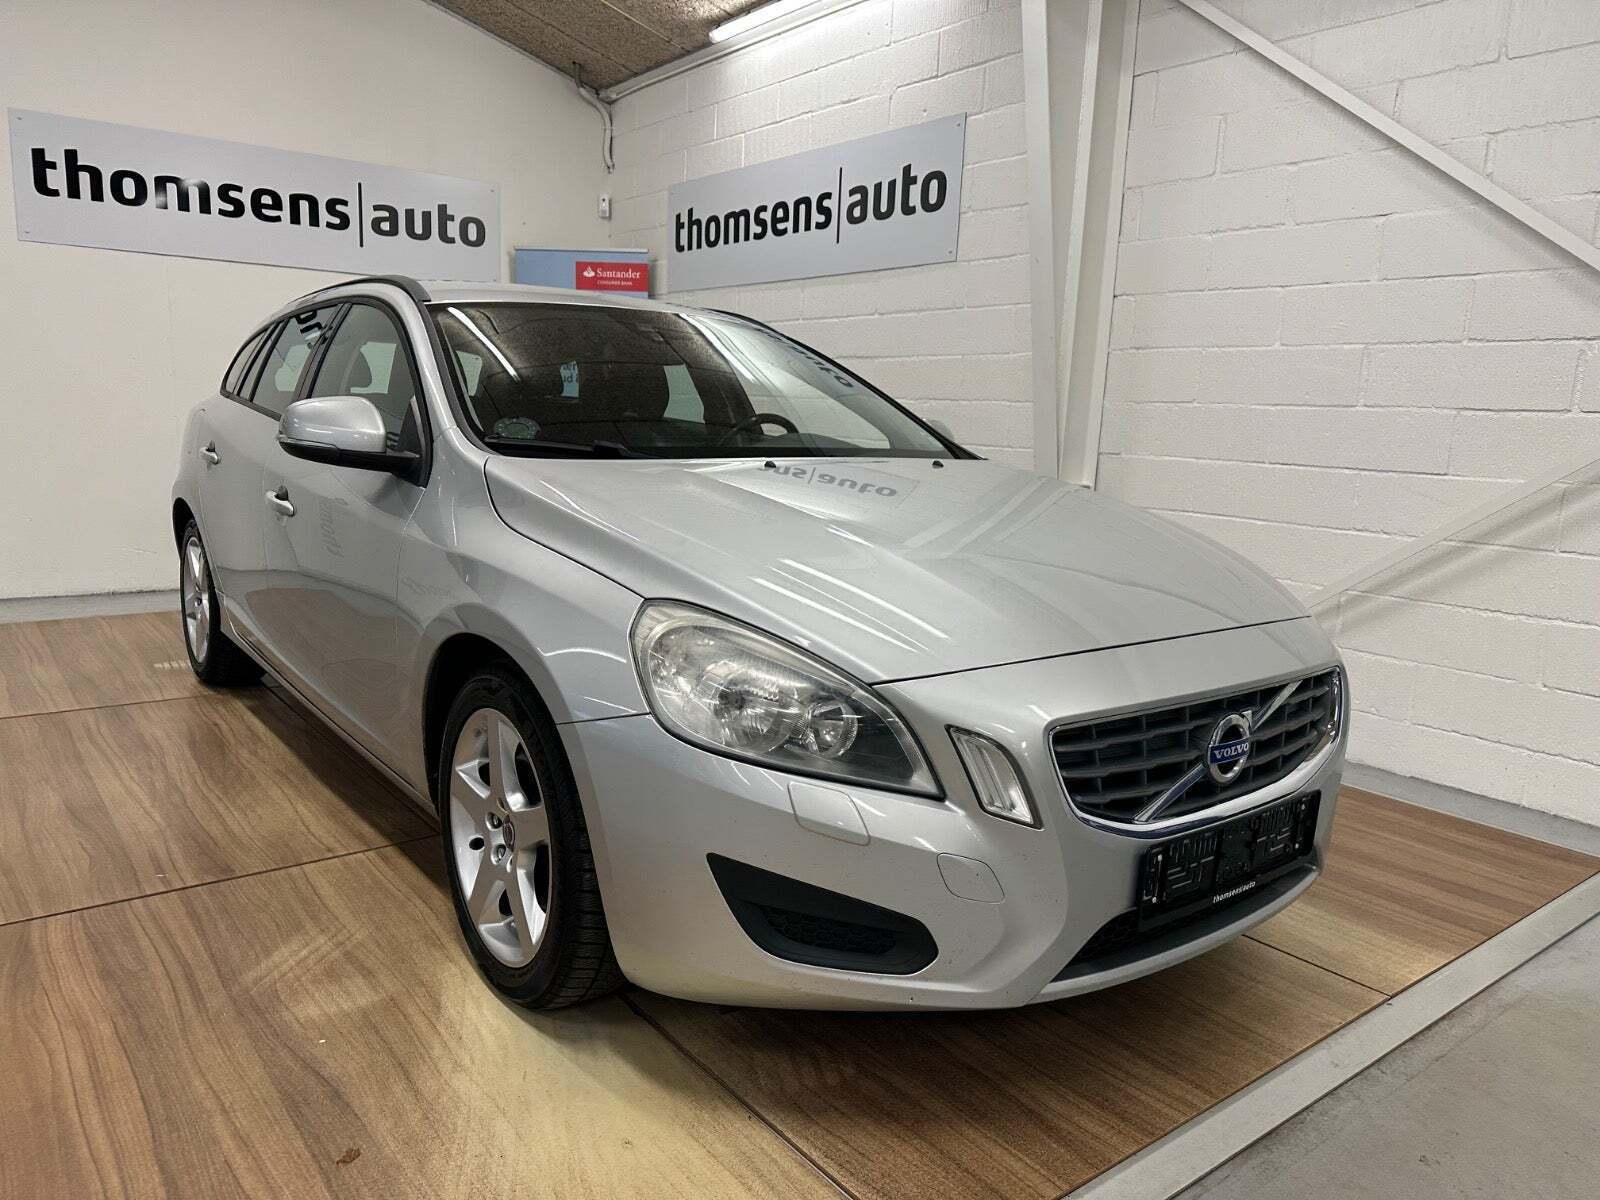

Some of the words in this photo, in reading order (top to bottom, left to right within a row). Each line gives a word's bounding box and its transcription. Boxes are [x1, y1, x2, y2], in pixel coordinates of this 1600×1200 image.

[31, 147, 351, 231] thomsens
[371, 203, 486, 248] auto
[675, 191, 833, 253] thomsens
[846, 163, 948, 225] auto
[596, 267, 641, 279] Santander
[1214, 742, 1249, 759] VOLVO
